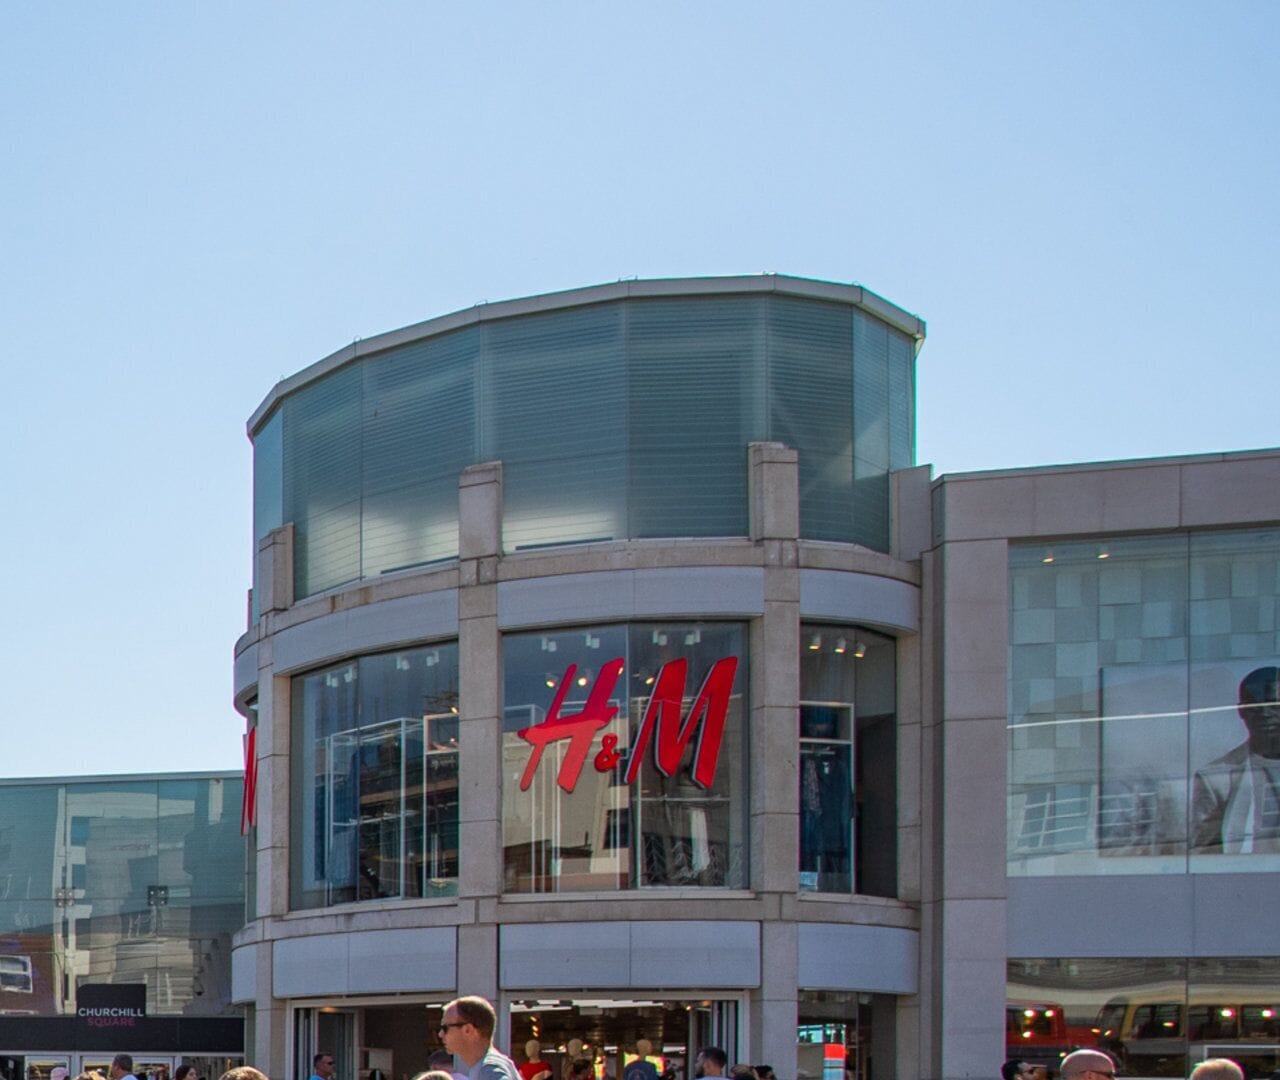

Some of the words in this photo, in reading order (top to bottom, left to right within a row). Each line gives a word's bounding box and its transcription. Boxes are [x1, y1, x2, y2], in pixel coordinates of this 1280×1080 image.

[518, 656, 738, 793] H&M
[78, 1007, 144, 1017] CHURCHILL
[87, 1018, 135, 1027] SQUARE
